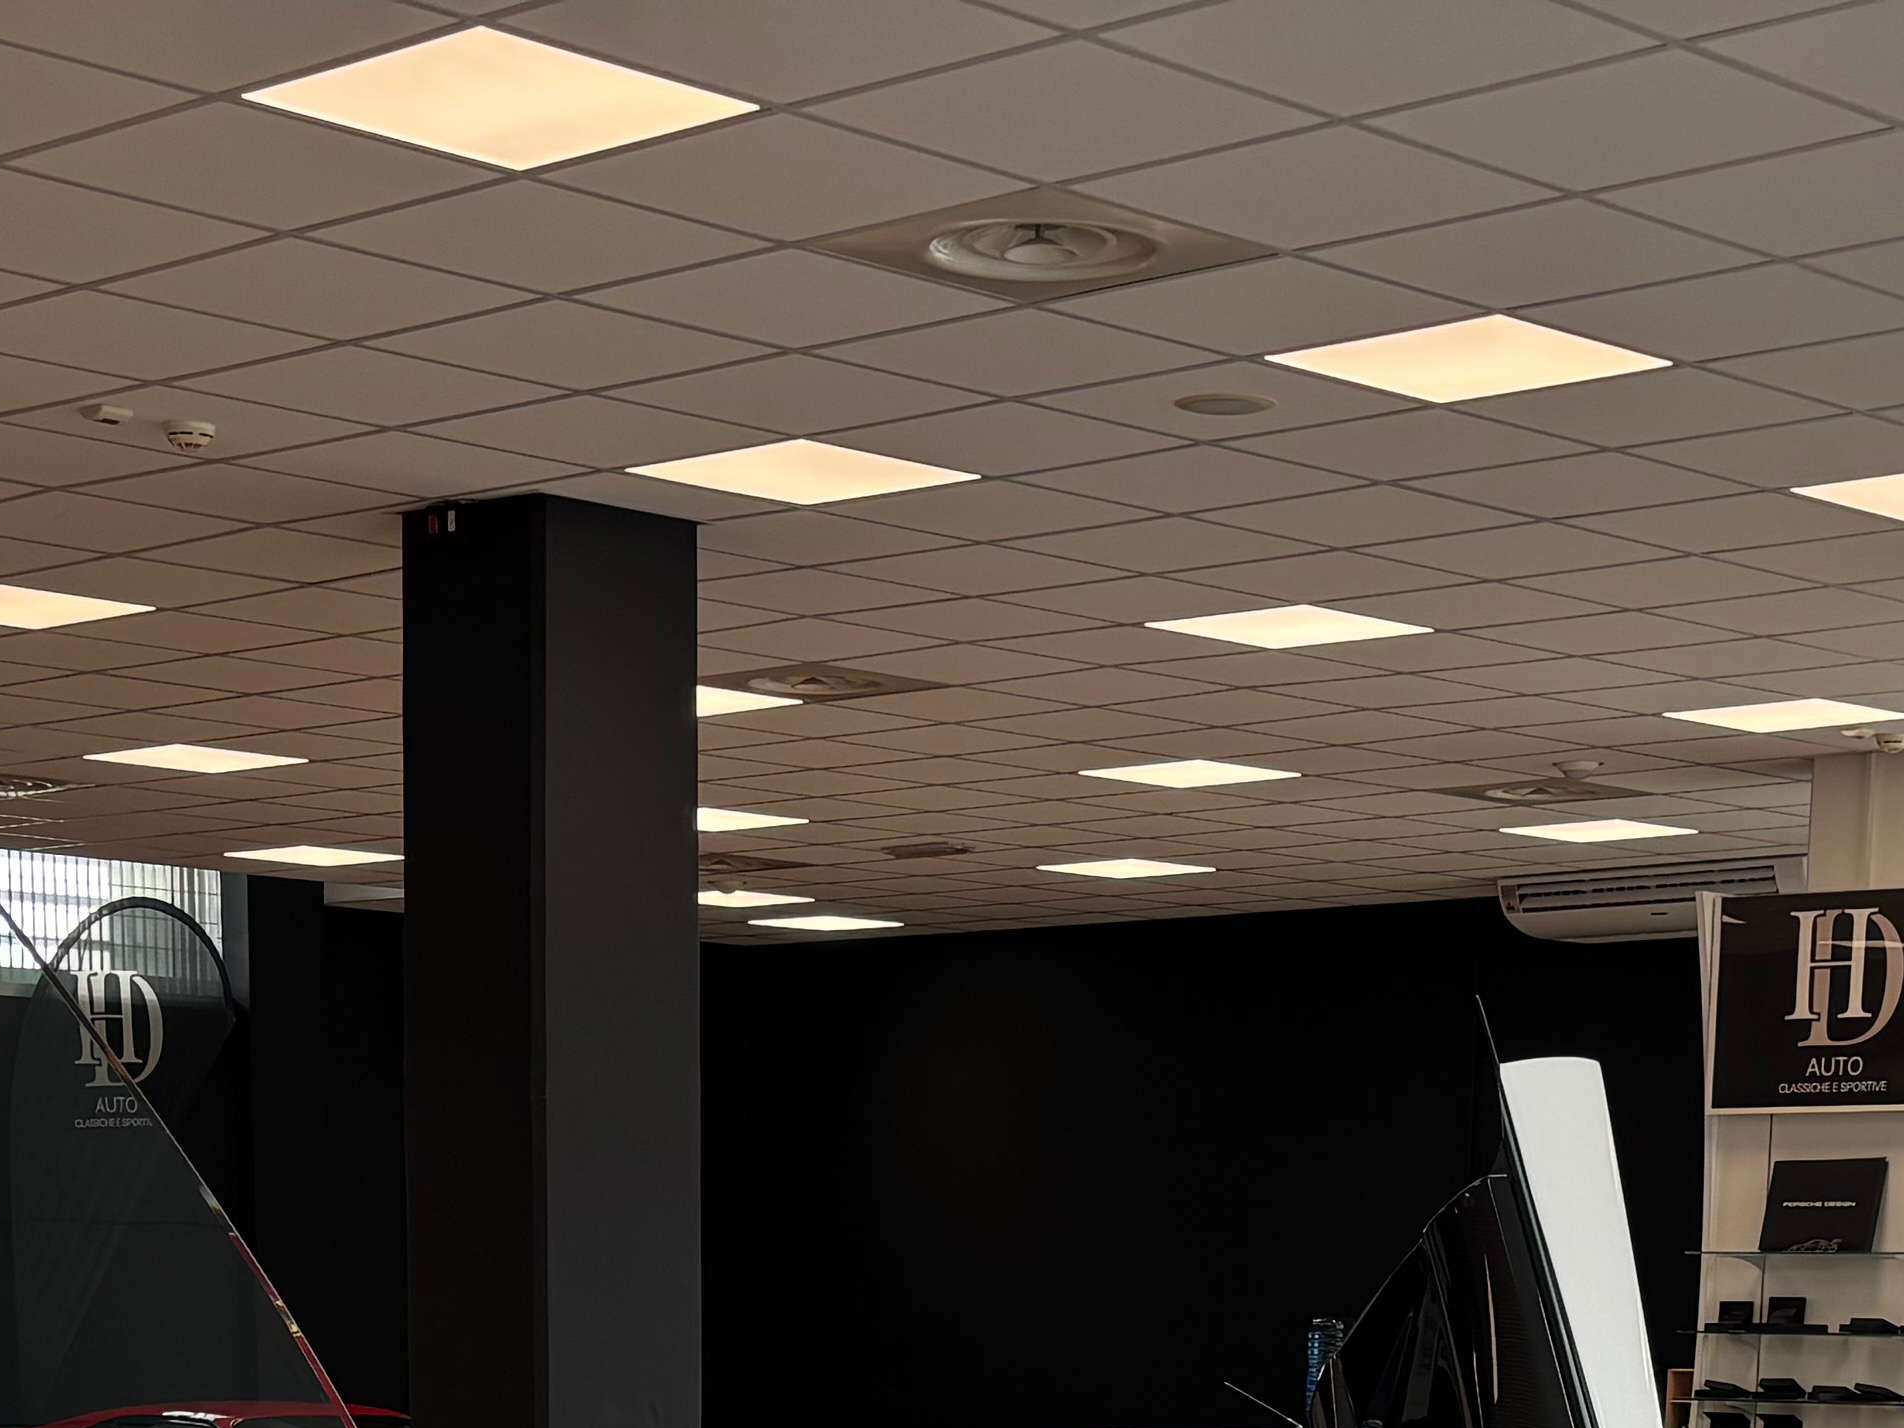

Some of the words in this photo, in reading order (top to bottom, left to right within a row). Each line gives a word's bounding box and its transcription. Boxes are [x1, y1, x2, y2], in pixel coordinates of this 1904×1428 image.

[1805, 1056, 1863, 1077] AUTO
[1778, 1082, 1830, 1094] CLASSICHE
[1832, 1082, 1839, 1093] E
[1840, 1080, 1888, 1093] SPORTIVE
[95, 1096, 138, 1114] AUTO
